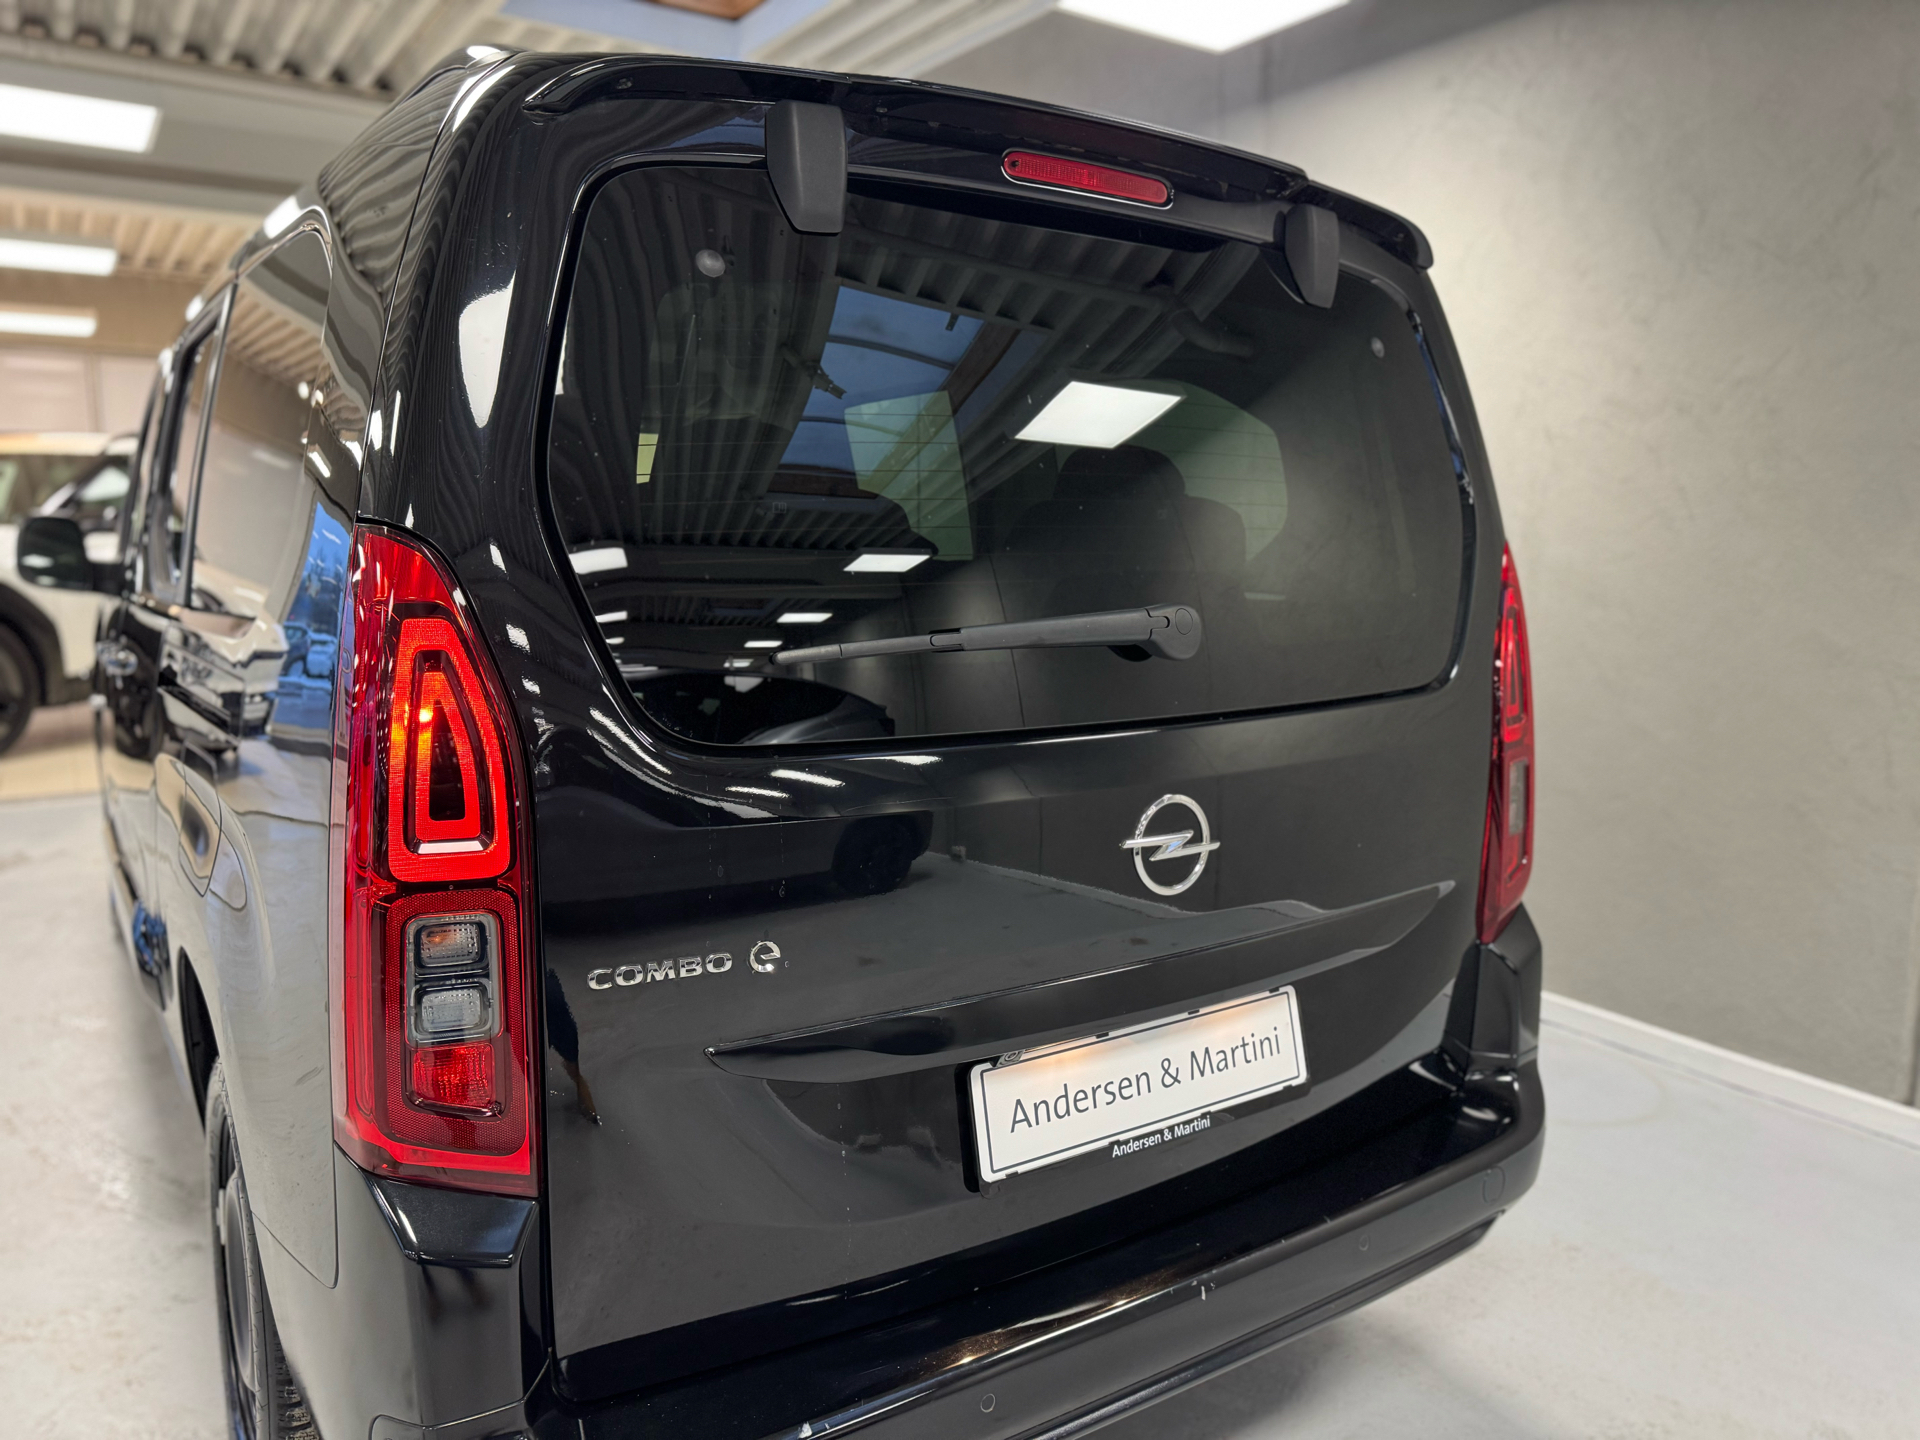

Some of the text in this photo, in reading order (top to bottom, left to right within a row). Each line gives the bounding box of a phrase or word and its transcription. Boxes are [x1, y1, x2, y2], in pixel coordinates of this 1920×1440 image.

[587, 952, 733, 990] COMBO
[1010, 1026, 1281, 1133] Andersen & Martini
[1112, 1115, 1211, 1158] Andersen & Martini
